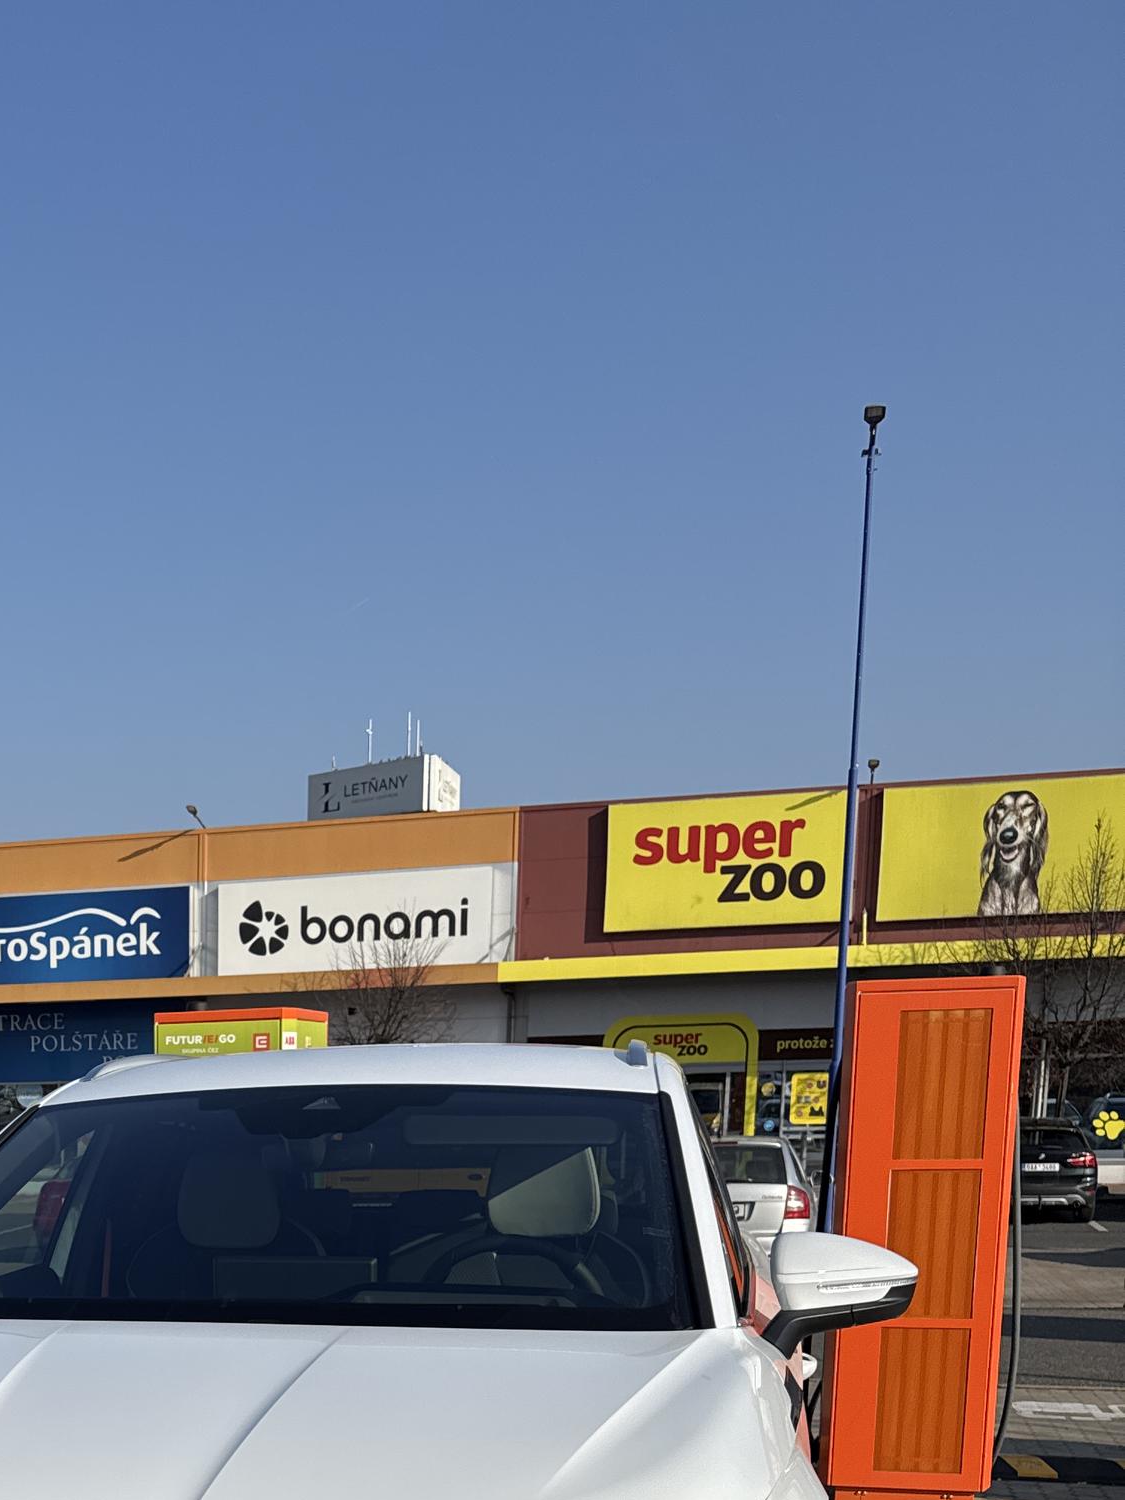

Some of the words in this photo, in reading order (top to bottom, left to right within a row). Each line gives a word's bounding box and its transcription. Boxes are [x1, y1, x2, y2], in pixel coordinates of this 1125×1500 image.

[343, 774, 408, 798] LETŇANY
[632, 817, 806, 874] super
[300, 897, 469, 946] bonami
[30, 1030, 140, 1053] POLŠTÁŘE
[653, 1032, 703, 1048] super
[777, 1035, 827, 1053] protože
